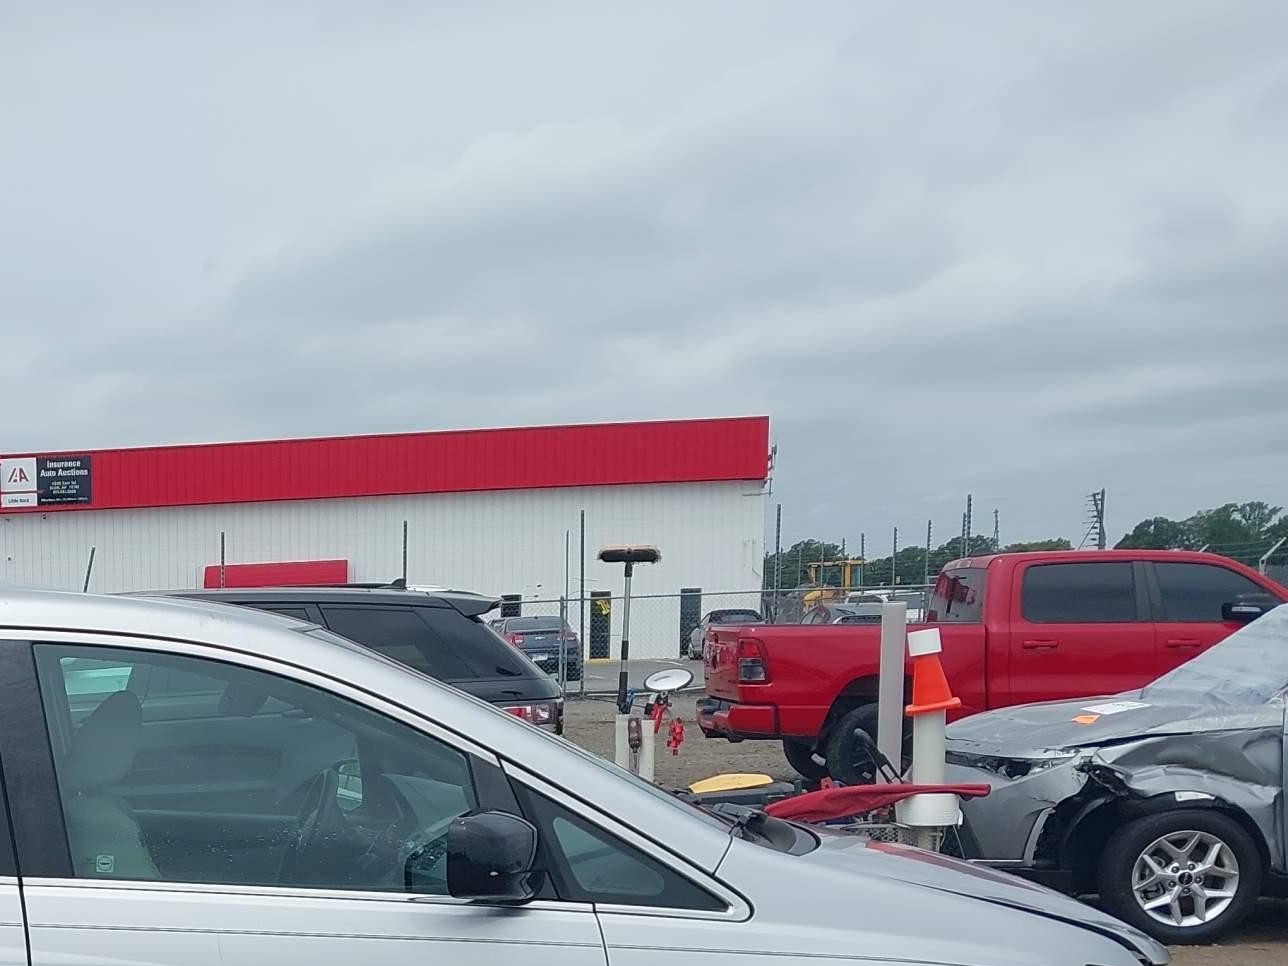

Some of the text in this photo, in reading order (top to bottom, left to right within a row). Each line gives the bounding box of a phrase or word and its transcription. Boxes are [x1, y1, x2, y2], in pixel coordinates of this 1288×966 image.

[46, 460, 81, 468] Insurance
[40, 468, 89, 477] Auto Auctions
